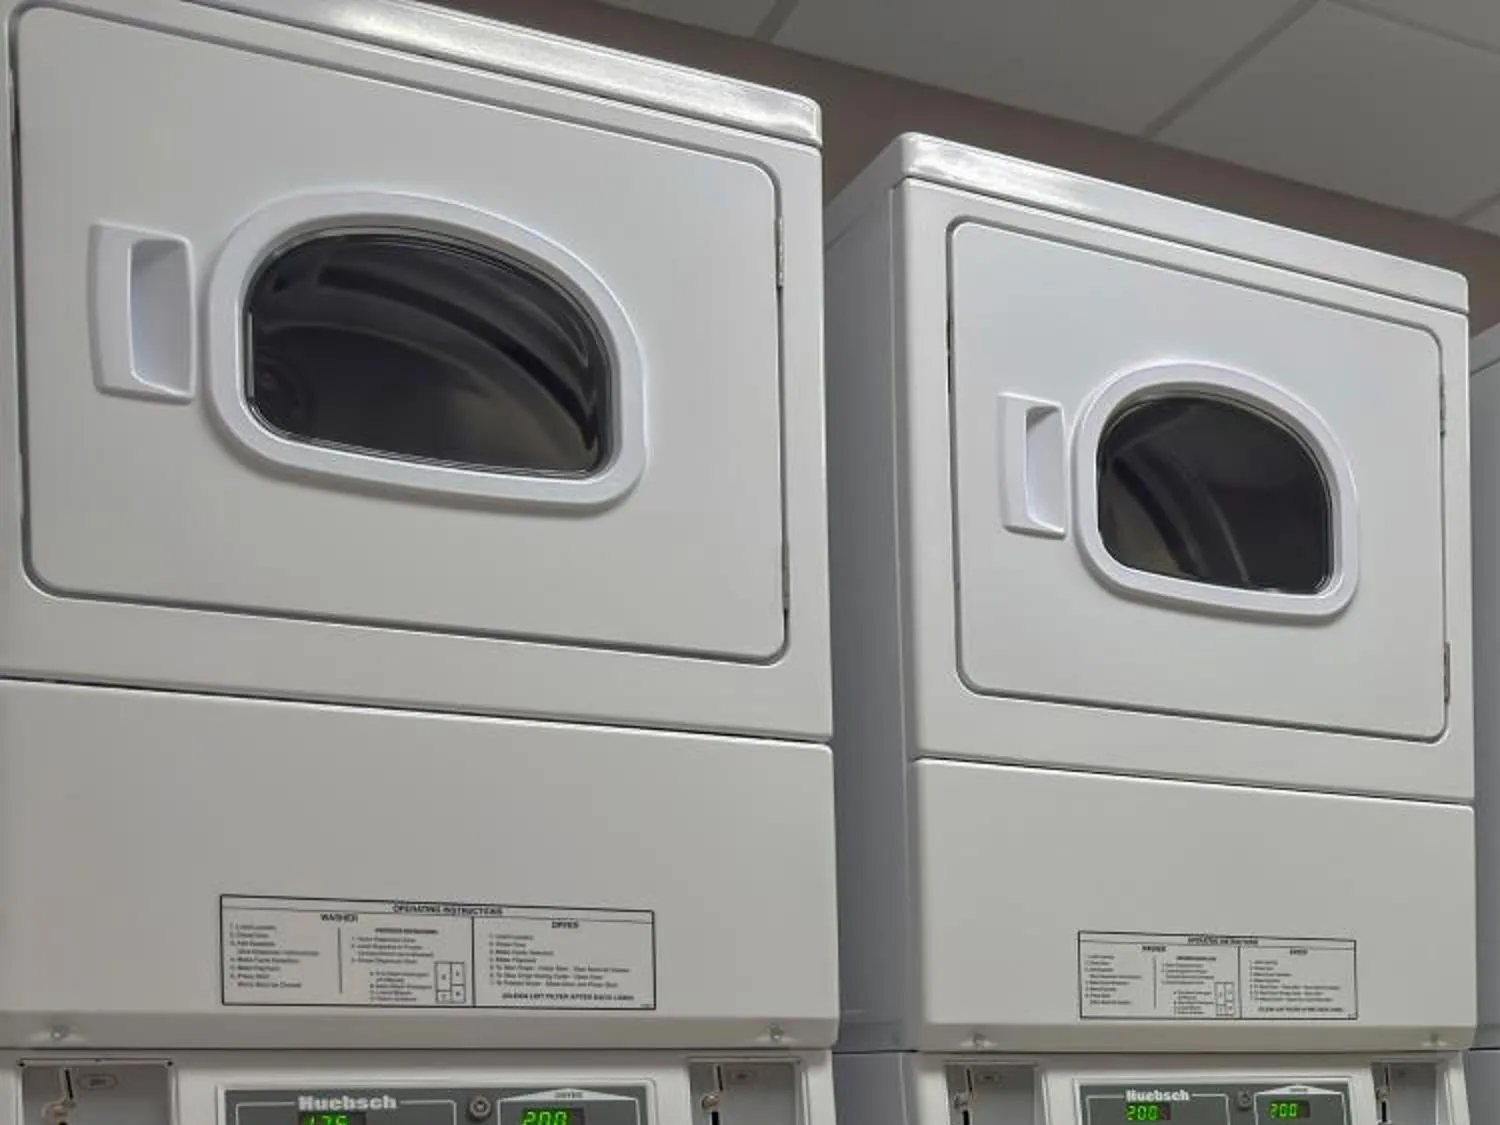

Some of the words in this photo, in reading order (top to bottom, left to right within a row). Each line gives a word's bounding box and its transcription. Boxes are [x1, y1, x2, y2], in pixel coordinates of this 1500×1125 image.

[298, 1095, 397, 1111] Huebsch
[1125, 1089, 1190, 1102] Huebsch
[1126, 1105, 1159, 1121] 200
